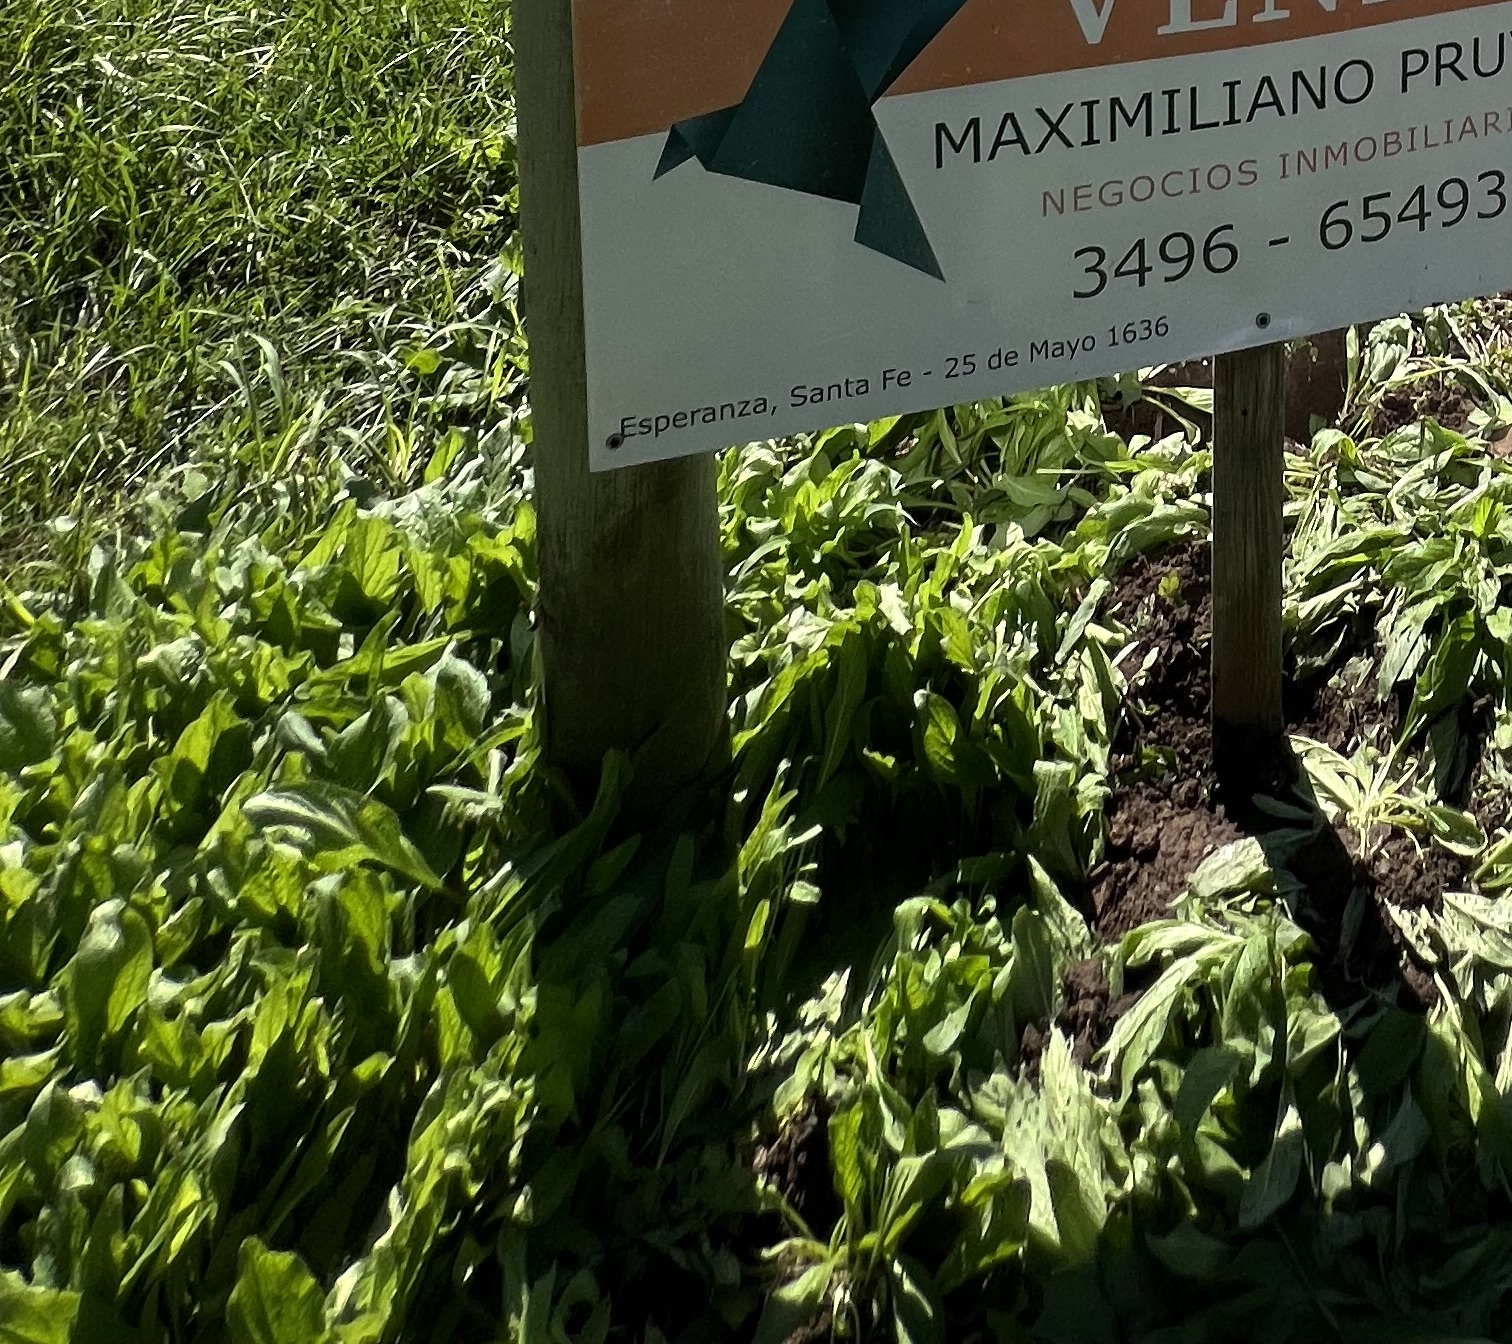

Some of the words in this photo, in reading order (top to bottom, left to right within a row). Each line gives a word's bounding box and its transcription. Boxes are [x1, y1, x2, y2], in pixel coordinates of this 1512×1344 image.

[934, 58, 1374, 169] MAXIMILIANO
[1040, 158, 1259, 217] NEGOCIOS
[1072, 223, 1240, 299] 3496
[1268, 233, 1290, 247] -
[619, 397, 779, 439] Esperanza,
[789, 374, 870, 408] Santa
[881, 367, 912, 392] Fe
[944, 353, 977, 379] 25
[987, 345, 1019, 371] de
[1030, 332, 1096, 364] Mayo
[1107, 315, 1170, 347] 1636
